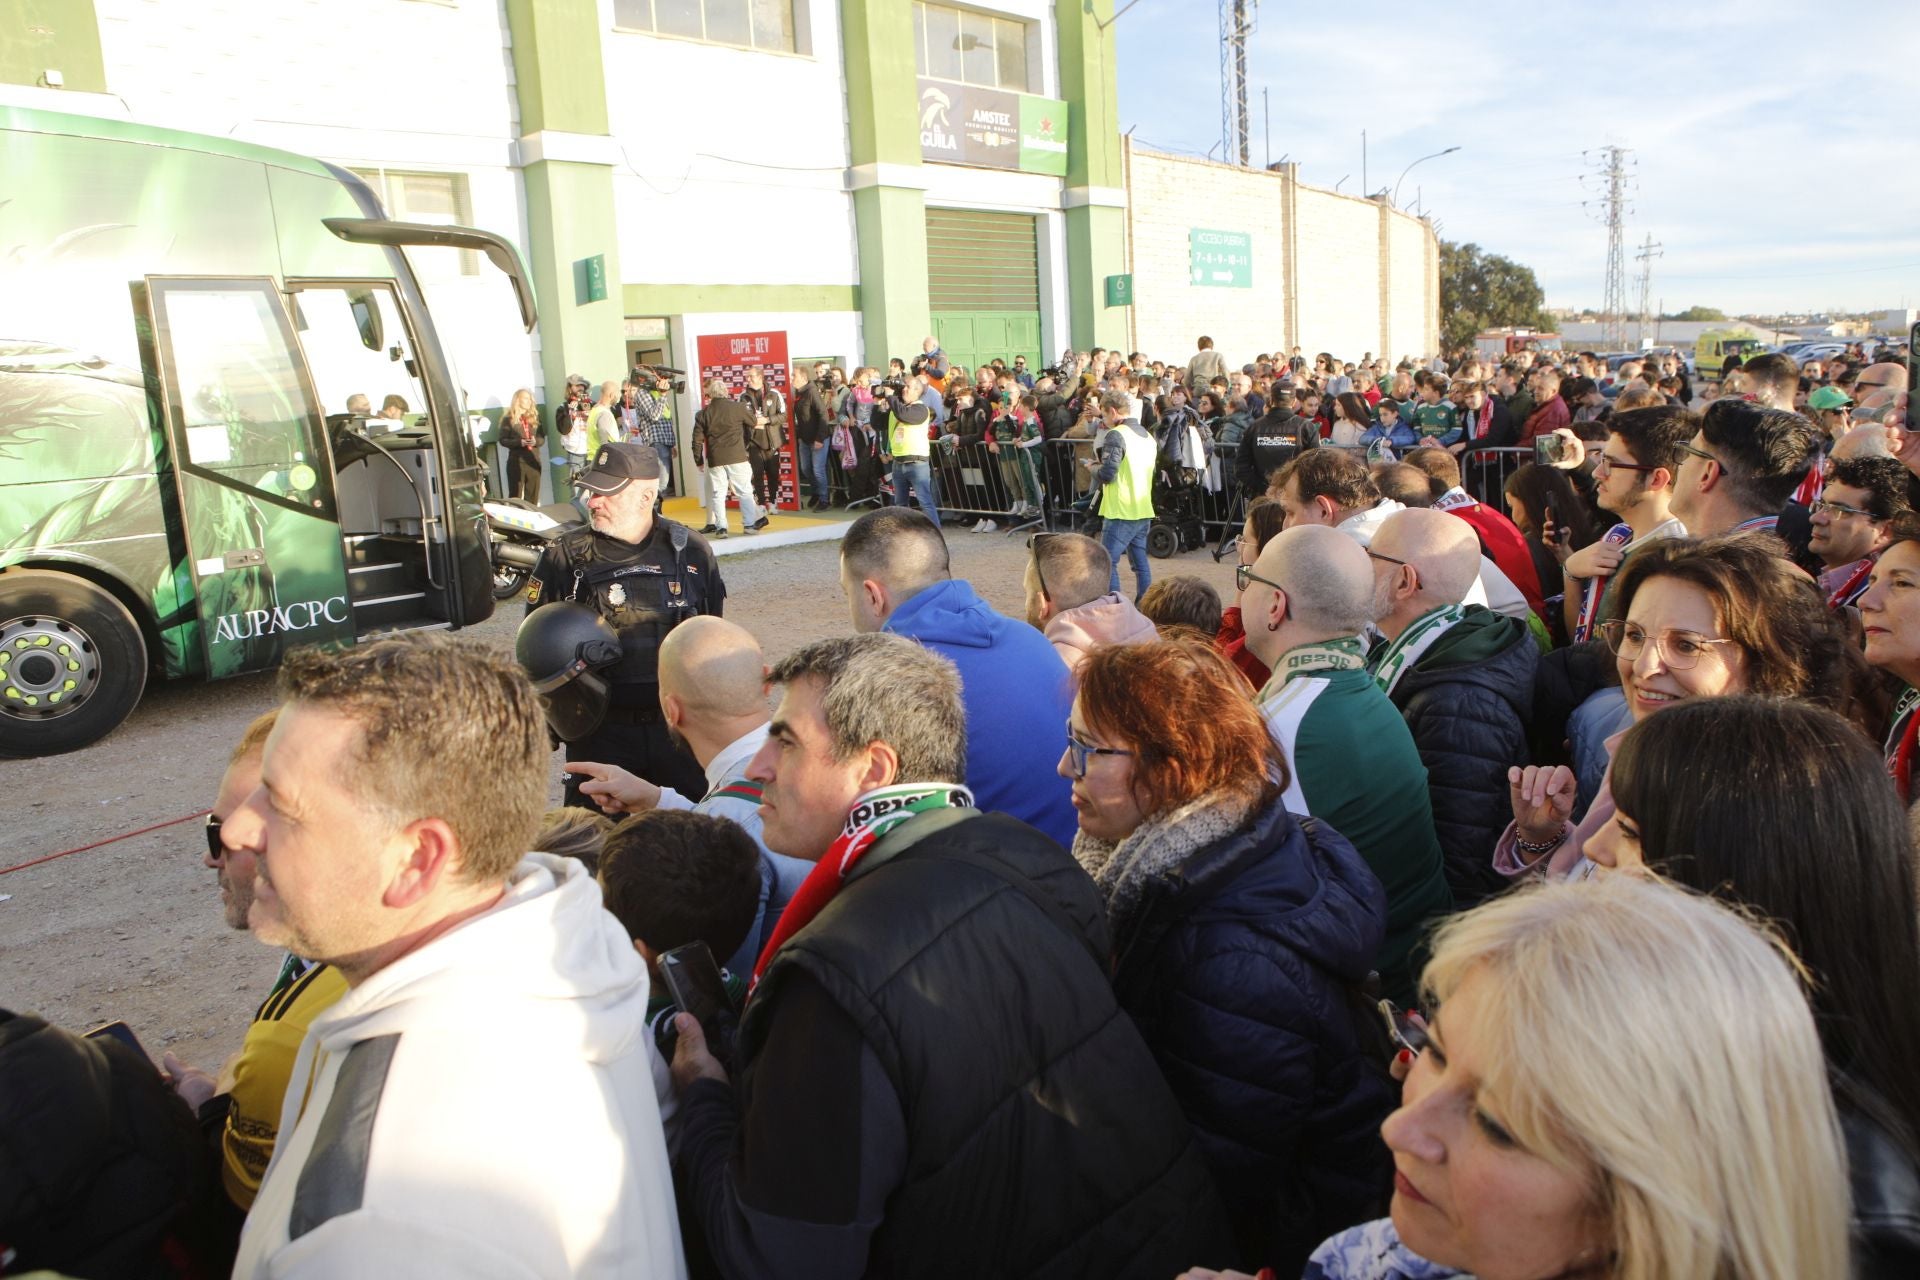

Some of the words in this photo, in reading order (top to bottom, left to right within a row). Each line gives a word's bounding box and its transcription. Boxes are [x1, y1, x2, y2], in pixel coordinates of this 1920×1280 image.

[972, 109, 1011, 126] AMSTEL
[919, 130, 957, 150] GUILA
[593, 259, 600, 278] 5
[1116, 276, 1125, 290] 6
[730, 338, 750, 354] COPA
[755, 337, 769, 353] REY
